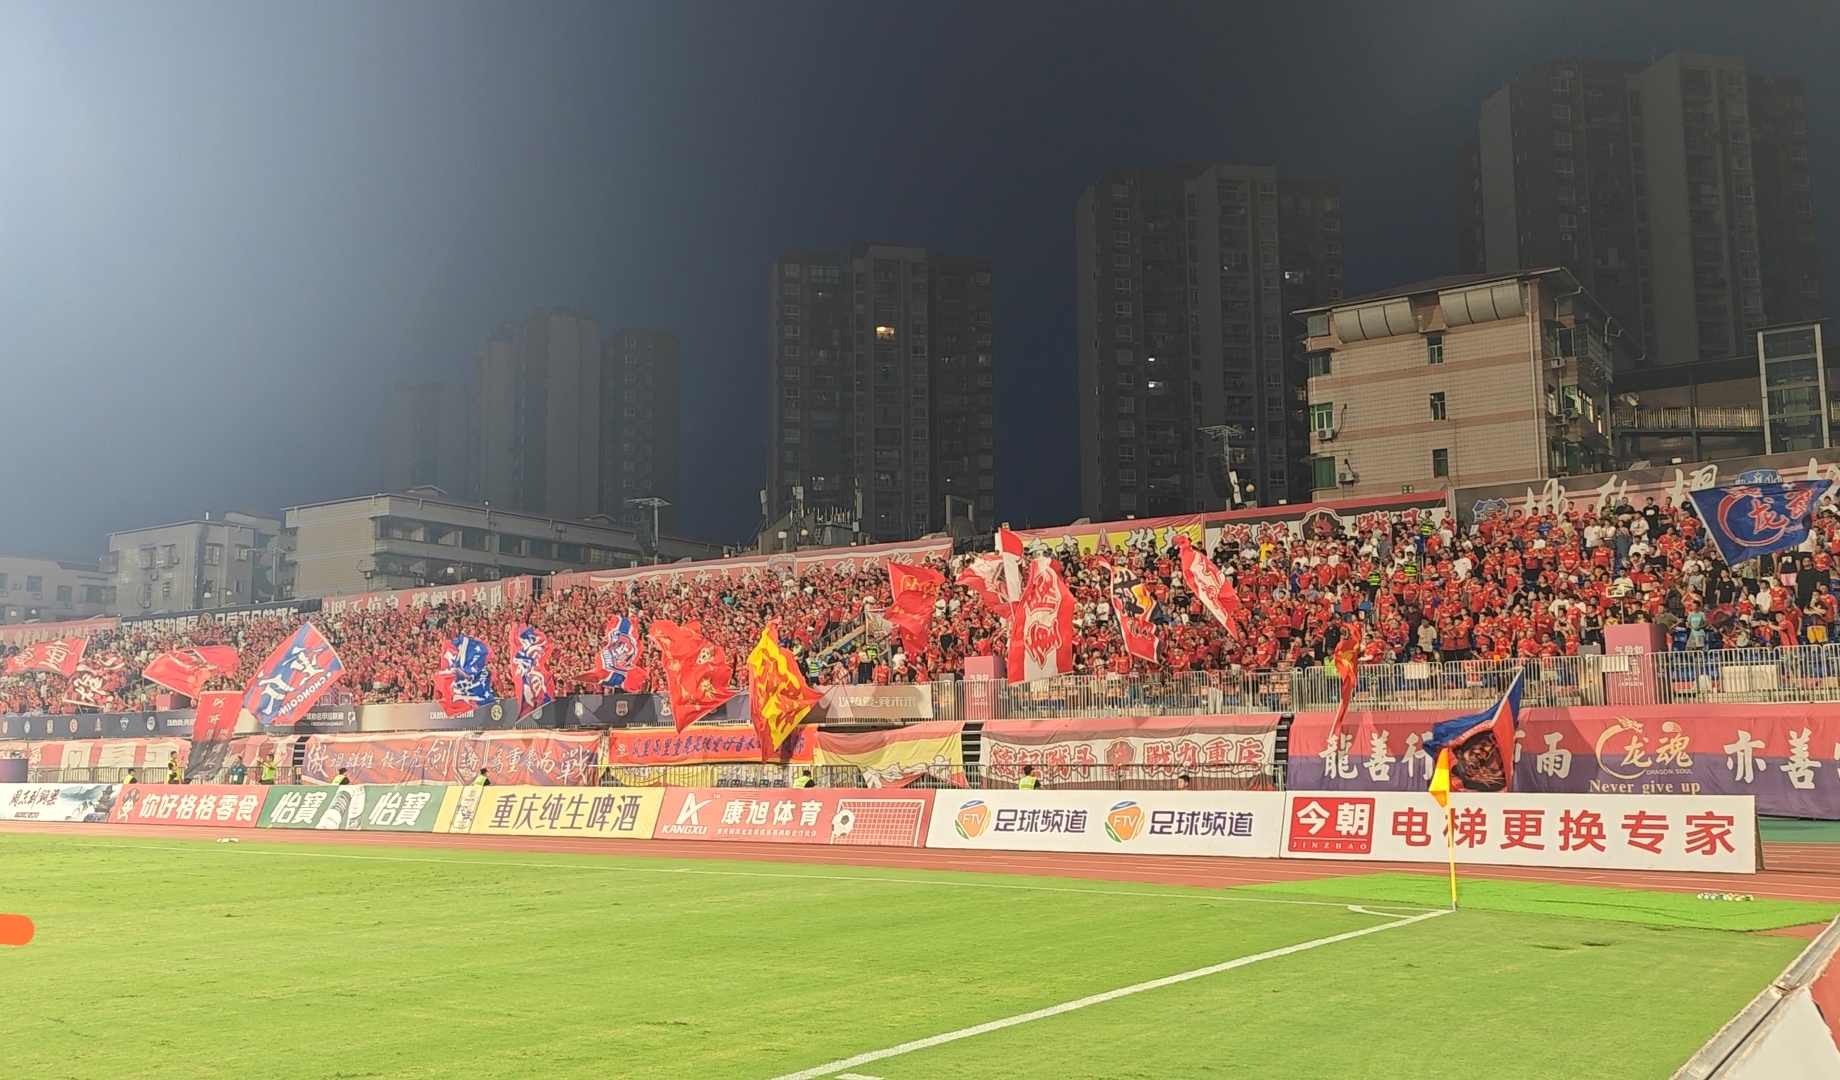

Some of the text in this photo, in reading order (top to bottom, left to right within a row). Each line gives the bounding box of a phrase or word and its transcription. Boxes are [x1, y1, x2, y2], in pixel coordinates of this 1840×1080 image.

[1621, 733, 1693, 767] 龙魂
[1589, 779, 1701, 794] Never give up
[139, 793, 259, 822] 你好格格零食
[270, 791, 328, 825] 怡寶
[369, 791, 431, 827] 怡寶
[488, 793, 643, 832] 重庆纯生啤酒
[720, 799, 823, 827] 康旭体育
[962, 809, 1088, 833] FTV 足球频道
[1296, 800, 1371, 836] 今朝
[661, 824, 708, 835] KANGXU
[1112, 811, 1254, 837] FTV 足球频道
[1391, 807, 1736, 855] 电梯更换专家
[1292, 841, 1367, 850] JINZHAO
